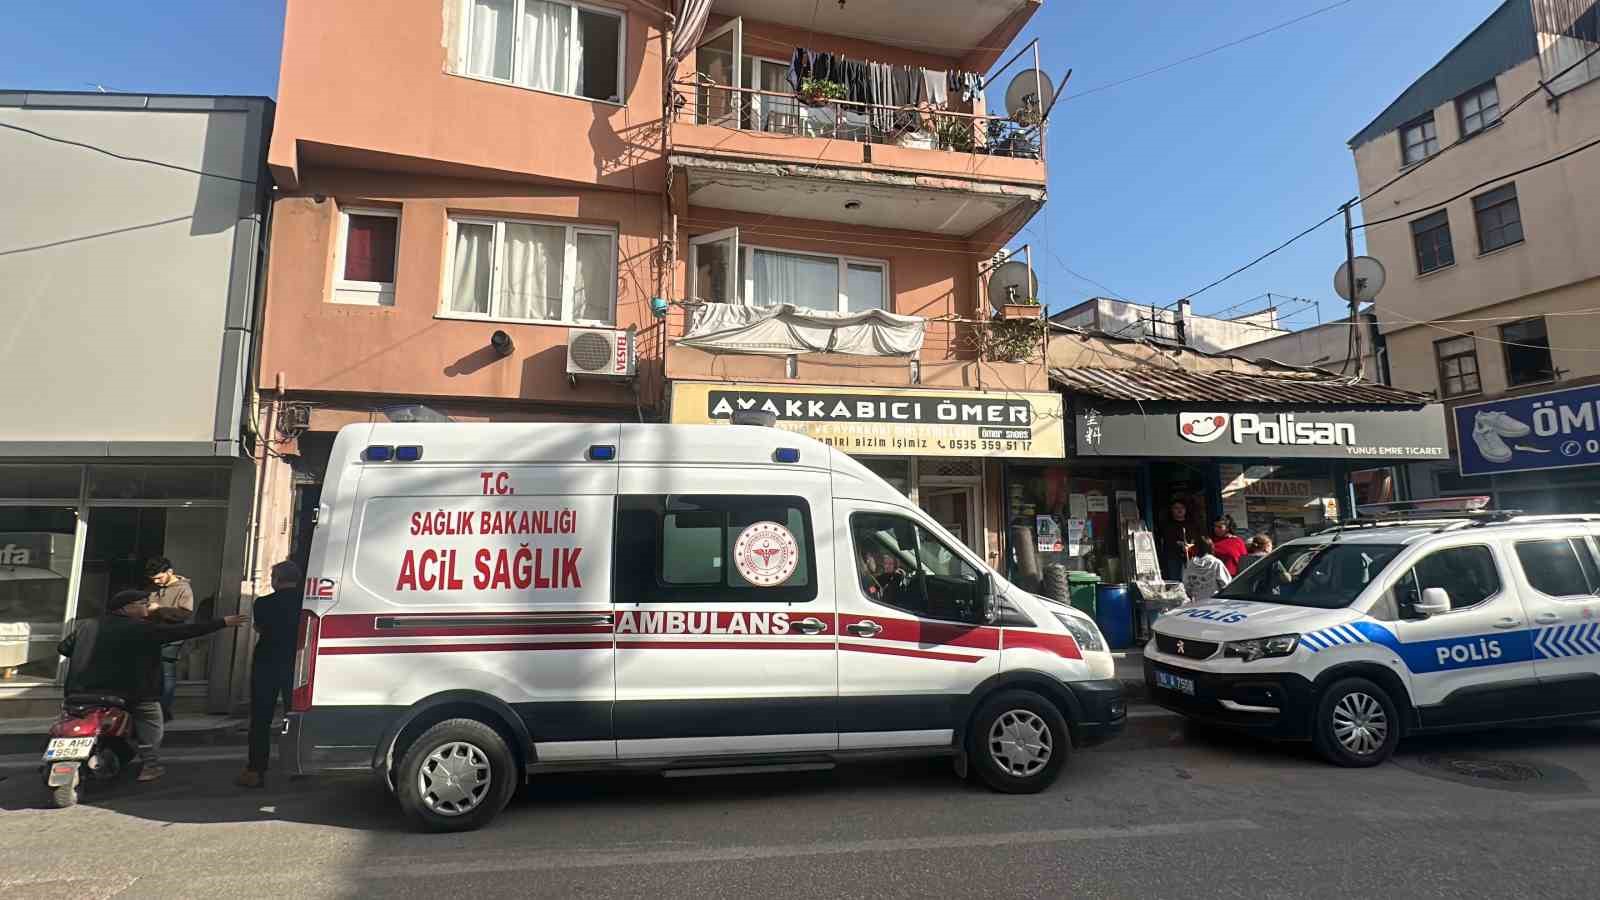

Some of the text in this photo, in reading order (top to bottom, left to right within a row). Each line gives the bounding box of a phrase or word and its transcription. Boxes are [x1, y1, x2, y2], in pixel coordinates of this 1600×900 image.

[712, 397, 1029, 423] AYAKKABICI ÖMER
[1532, 400, 1600, 437] ÖM
[1233, 412, 1355, 445] Polisan
[949, 439, 977, 450] 0535
[981, 440, 1001, 450] 359
[1006, 440, 1018, 451] 51
[1346, 447, 1377, 455] YUNUS
[1379, 447, 1403, 455] EMRE
[480, 472, 514, 495] T.C.
[410, 507, 577, 535] SAĞLIK BAKANLIĞI
[473, 542, 583, 590] SAĞLIK
[305, 577, 335, 596] 112
[617, 611, 791, 634] AMBULANS
[1437, 637, 1503, 665] POLİS
